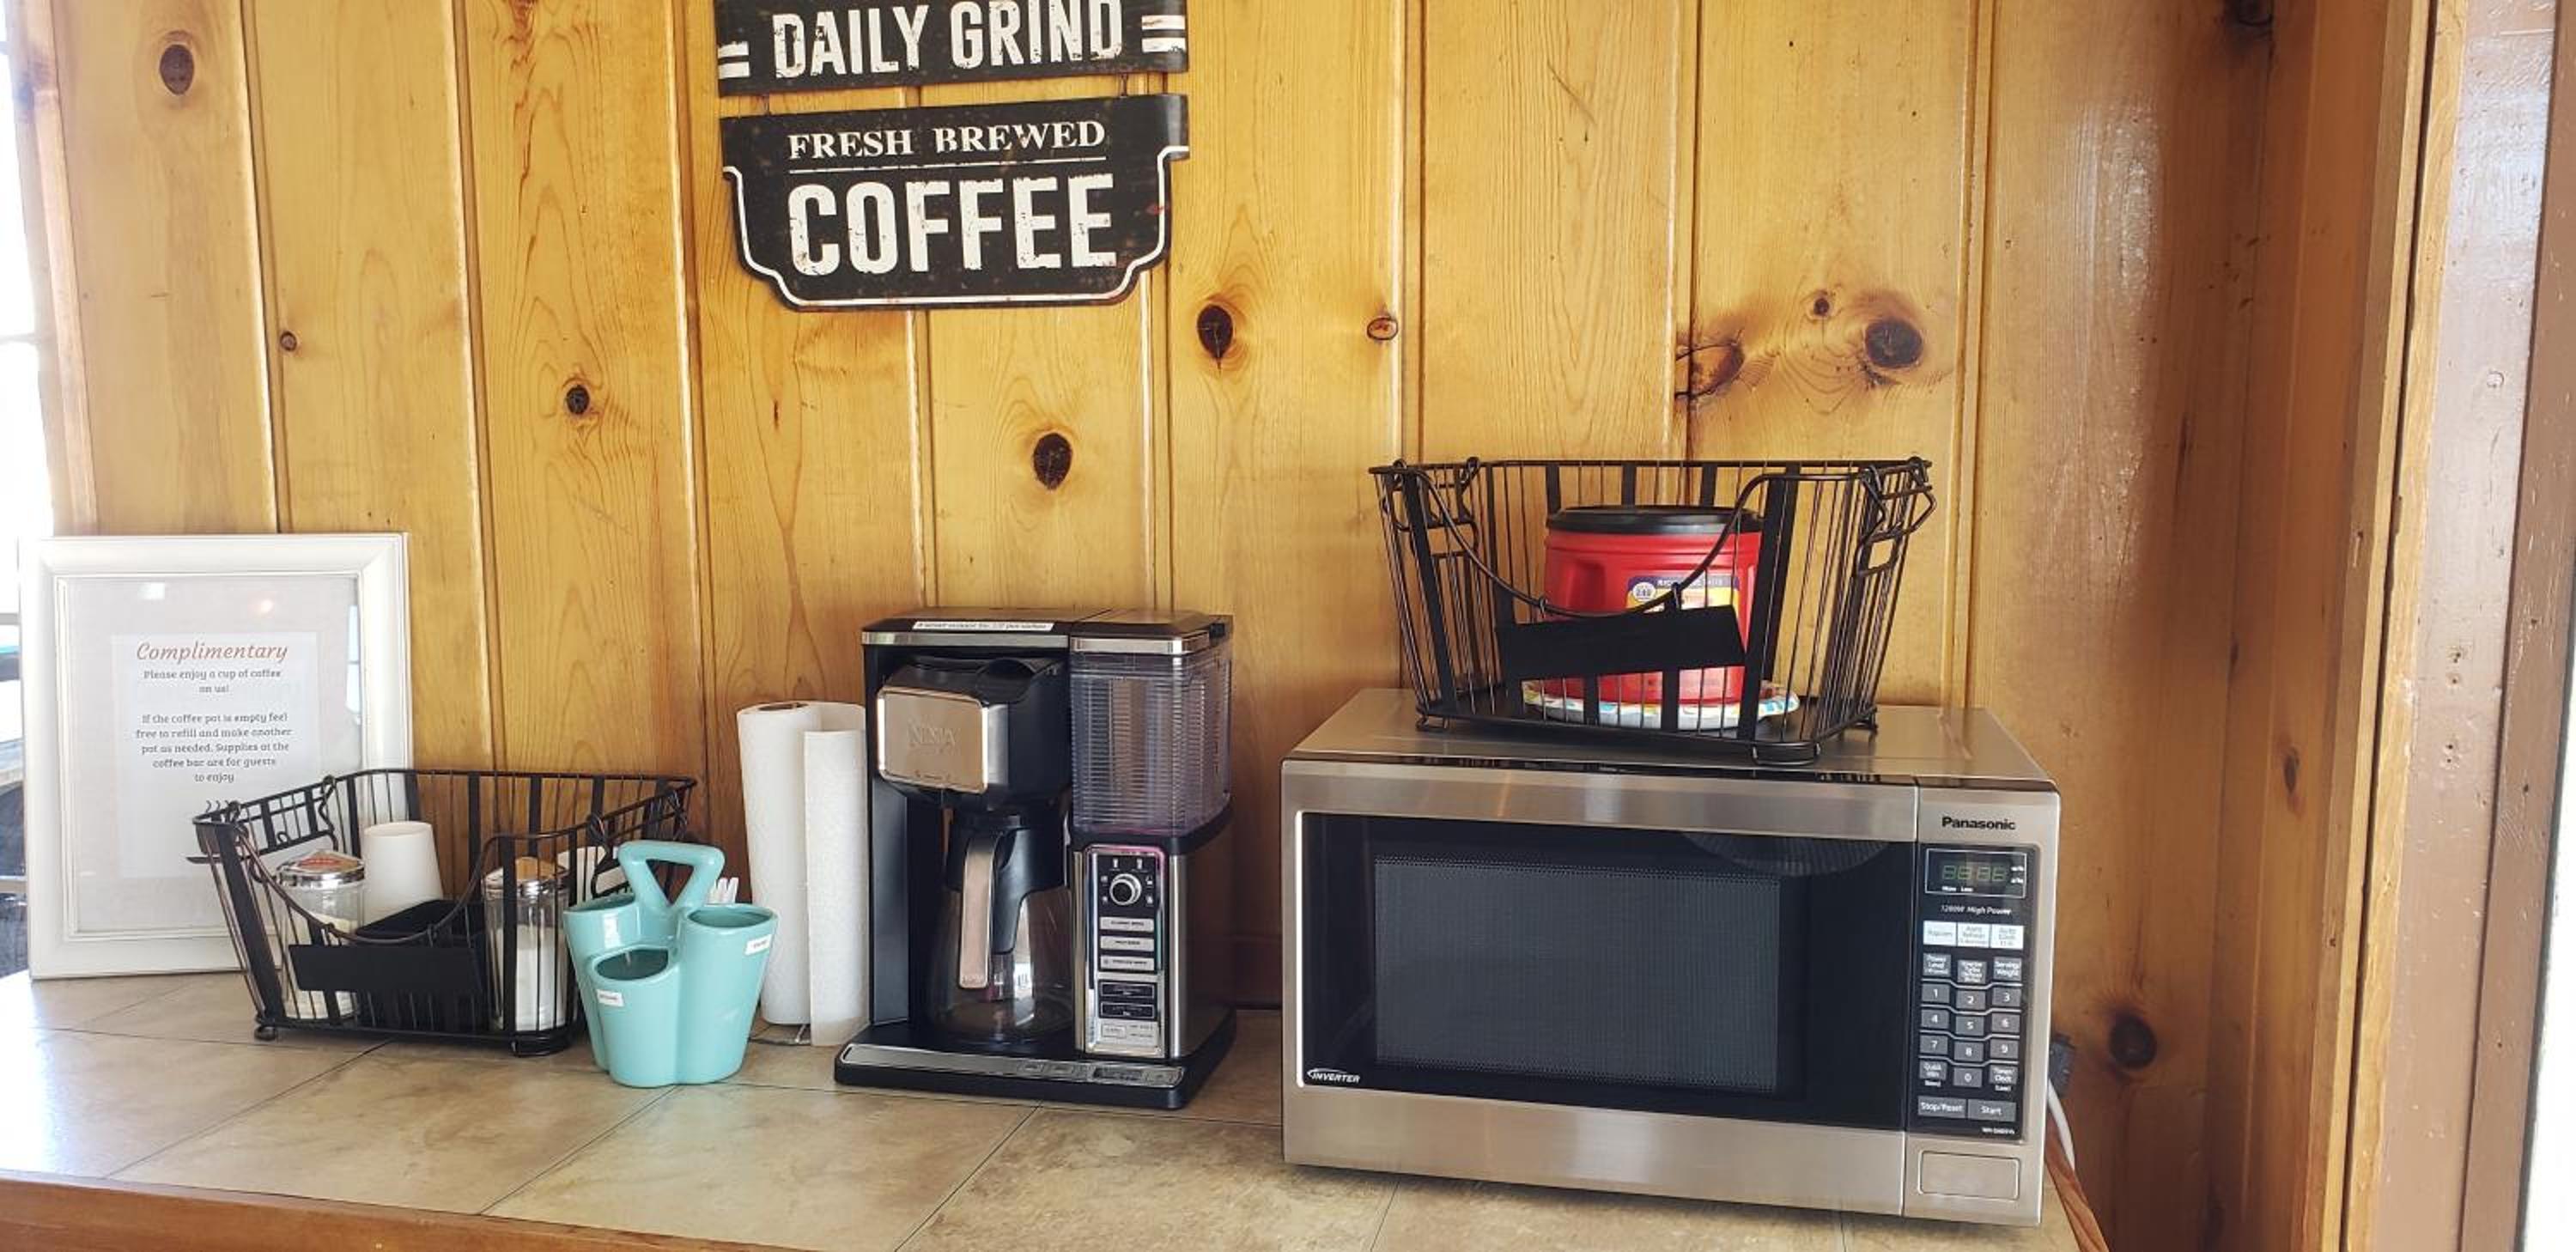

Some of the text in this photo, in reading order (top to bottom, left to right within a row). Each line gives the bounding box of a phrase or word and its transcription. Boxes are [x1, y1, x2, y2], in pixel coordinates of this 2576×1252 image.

[773, 0, 1122, 78] DAILY GRIND
[788, 120, 1105, 160] FRESH BREWED
[788, 173, 1116, 276] COFFEE
[137, 641, 289, 664] Complimentary
[143, 670, 176, 678] Please
[179, 670, 207, 680] enjoy
[217, 671, 236, 679] cup
[239, 669, 248, 678] of
[250, 669, 282, 678] coffee
[142, 713, 288, 724] If the coffee pot is empty feel
[137, 729, 157, 738] free
[172, 729, 197, 738] refill
[221, 728, 249, 737] make
[142, 745, 157, 754] pot
[174, 743, 214, 752] needed.
[216, 743, 258, 753] Supplies
[260, 743, 270, 751] at
[272, 742, 289, 751] the
[152, 758, 185, 768] coffee
[186, 758, 204, 767] bar
[226, 757, 241, 766] for
[243, 758, 276, 768] guests
[194, 774, 204, 782] to
[1941, 816, 2017, 830] Panasonic
[1967, 906, 1986, 915] High
[1987, 907, 2012, 915] Power
[1934, 988, 1938, 998] 1
[2004, 993, 2010, 1001] 3
[1967, 1021, 1974, 1030] 5
[2002, 1018, 2009, 1027] 6
[1931, 1040, 1938, 1048] 7
[2002, 1044, 2008, 1054] 9
[1965, 1047, 1972, 1056] 8
[1311, 1073, 1360, 1084] INVERTER
[1964, 1073, 1972, 1083] 0
[1921, 1102, 1964, 1112] Stop/Reset
[1981, 1104, 2002, 1115] Start
